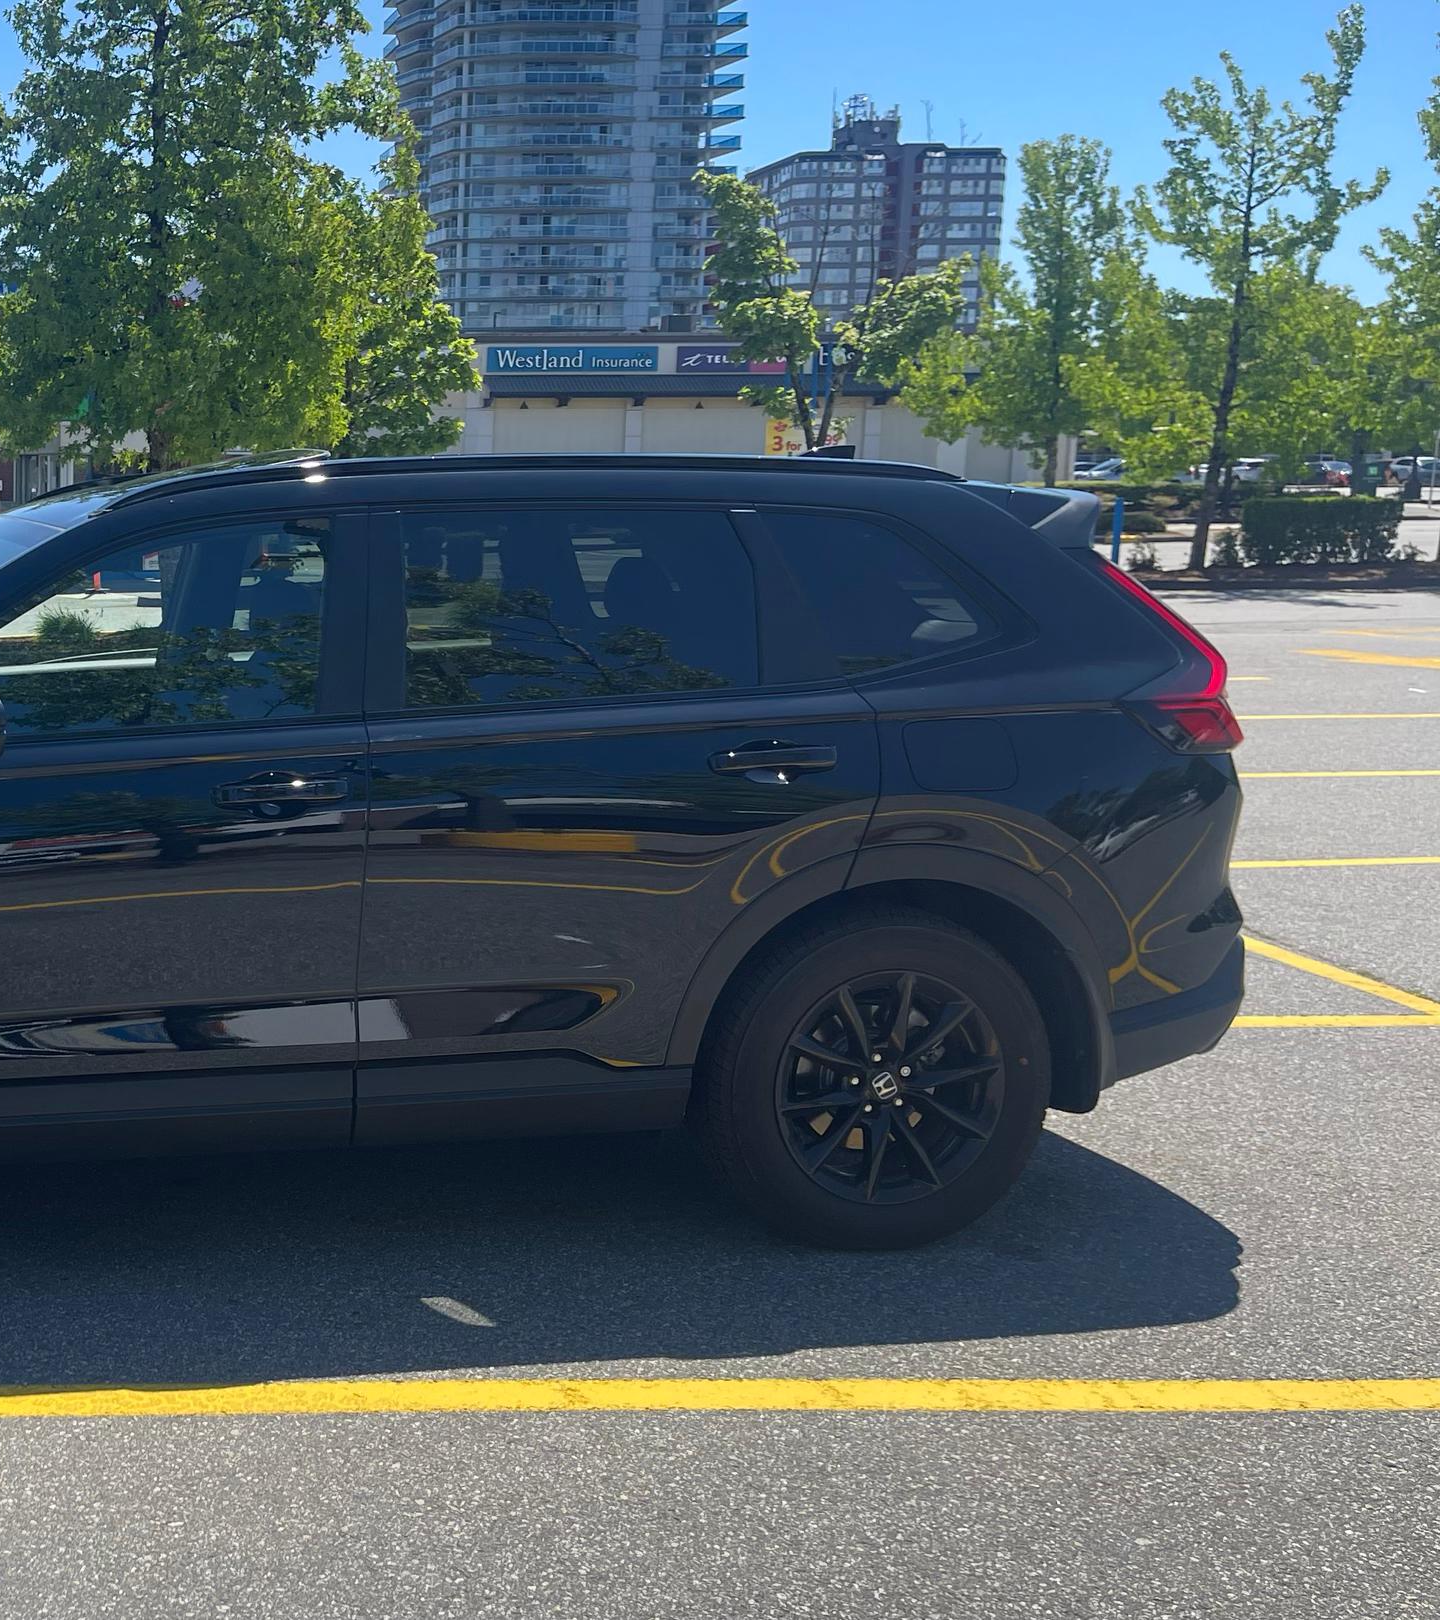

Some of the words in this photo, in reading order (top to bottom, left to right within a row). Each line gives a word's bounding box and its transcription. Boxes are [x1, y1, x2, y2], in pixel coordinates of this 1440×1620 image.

[497, 349, 583, 370] Westland
[592, 356, 652, 368] Insurance
[772, 436, 783, 451] 3
[786, 441, 802, 451] for
